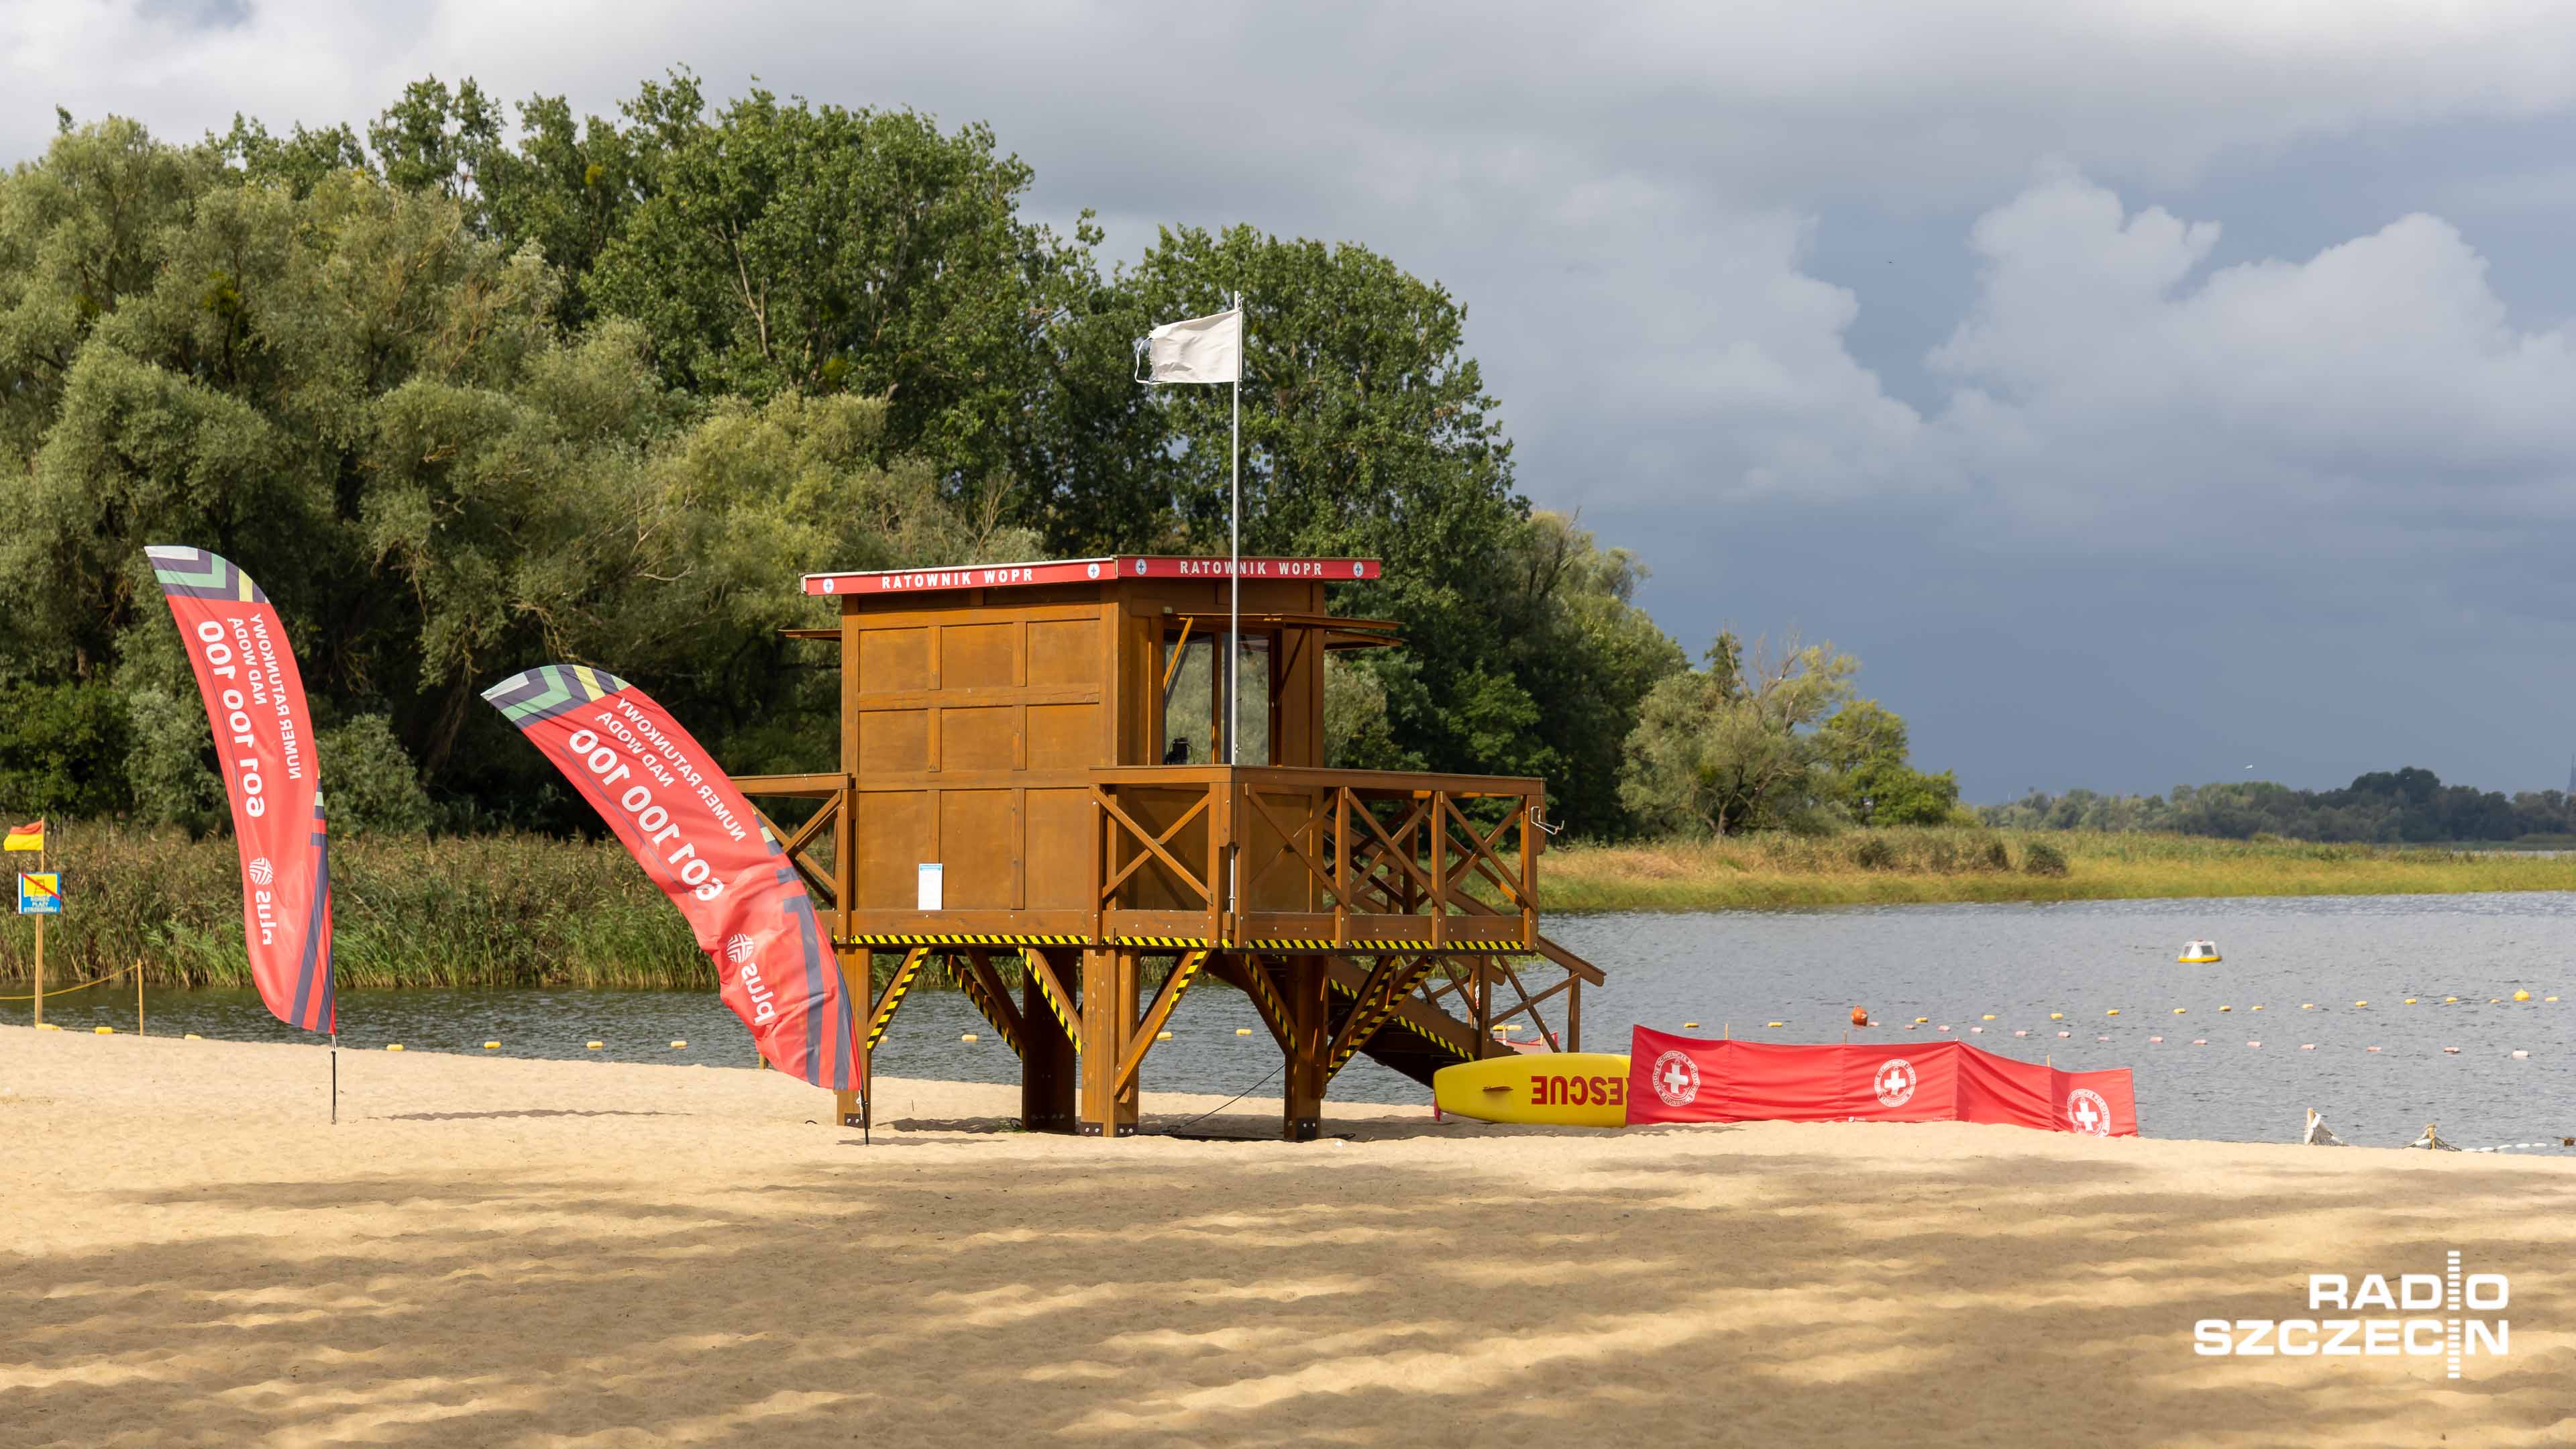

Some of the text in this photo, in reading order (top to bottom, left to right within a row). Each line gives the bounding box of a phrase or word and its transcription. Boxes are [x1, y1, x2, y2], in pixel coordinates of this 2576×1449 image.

[881, 568, 1033, 588] RATOWNIK WOPR
[1180, 561, 1322, 575] RATOWNIK WOPR
[1531, 1075, 1632, 1106] ESCUE
